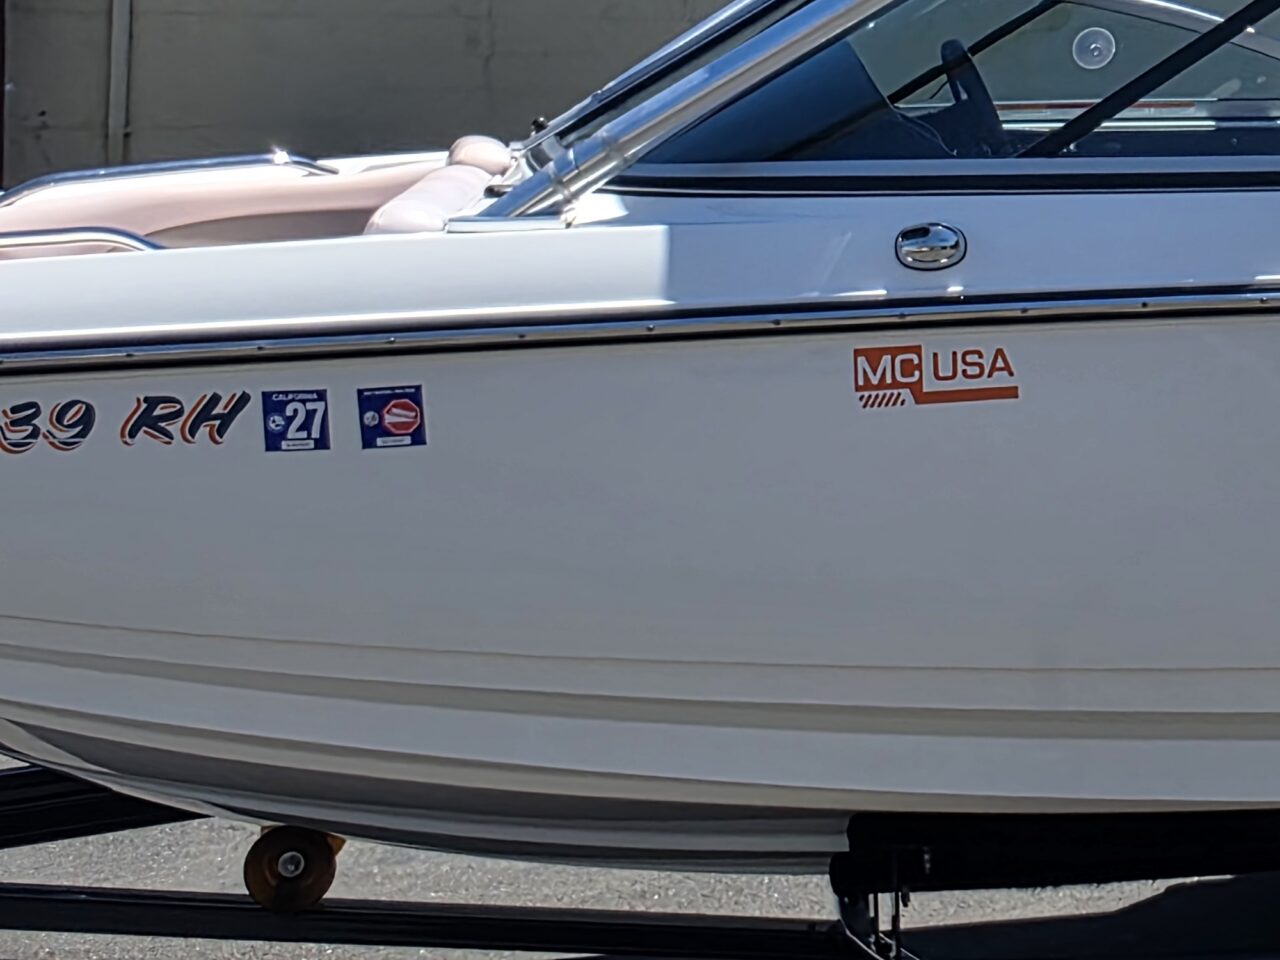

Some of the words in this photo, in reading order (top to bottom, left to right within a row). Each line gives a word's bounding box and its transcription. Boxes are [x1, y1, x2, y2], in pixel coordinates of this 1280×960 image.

[856, 352, 921, 387] MC
[932, 347, 1015, 382] USA
[0, 399, 96, 454] 39
[120, 390, 252, 446] RH
[285, 401, 326, 439] 27
